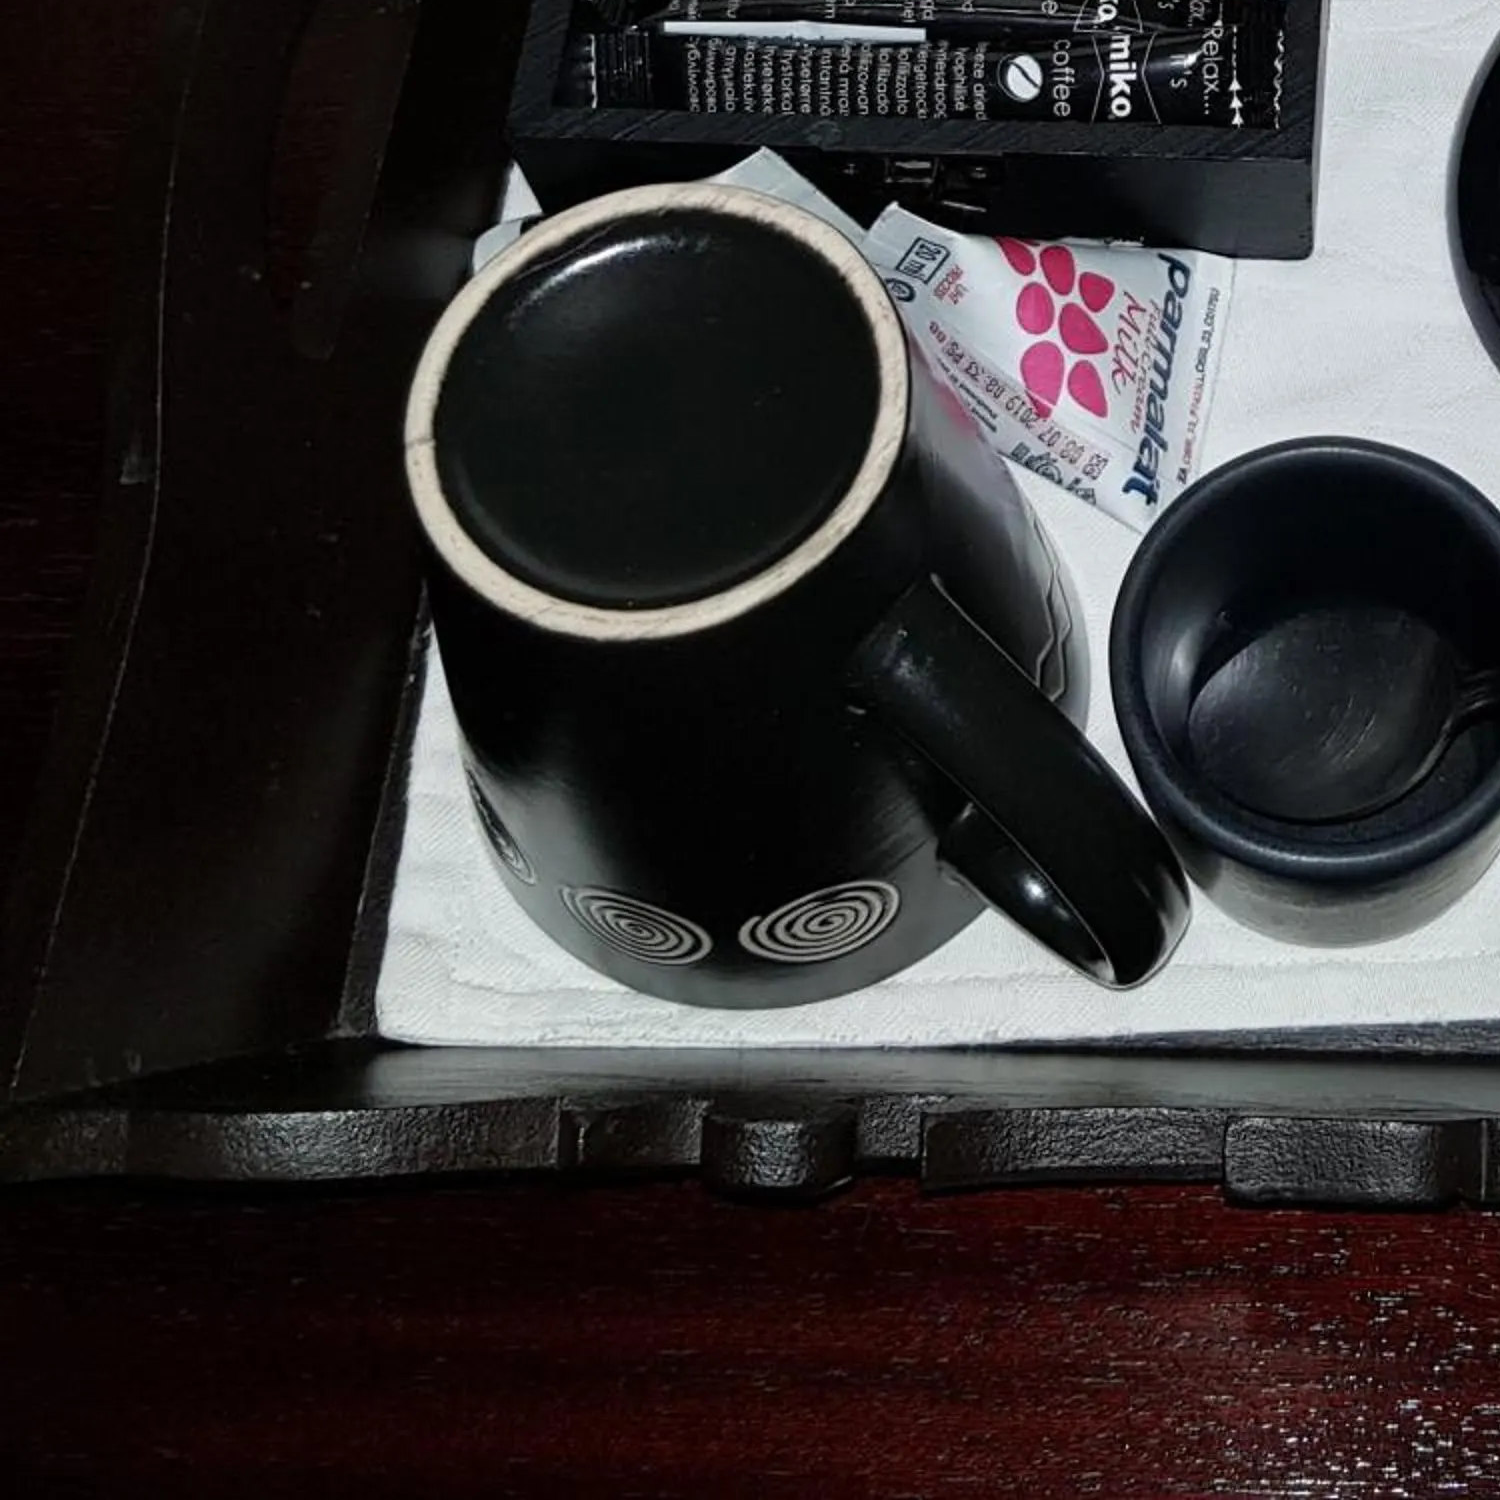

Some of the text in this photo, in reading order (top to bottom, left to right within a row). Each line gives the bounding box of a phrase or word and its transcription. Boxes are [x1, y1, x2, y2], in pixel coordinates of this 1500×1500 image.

[1053, 39, 1075, 117] coffee
[1109, 34, 1137, 117] miko
[1111, 291, 1148, 396] Milk
[1122, 252, 1192, 506] parmalat
